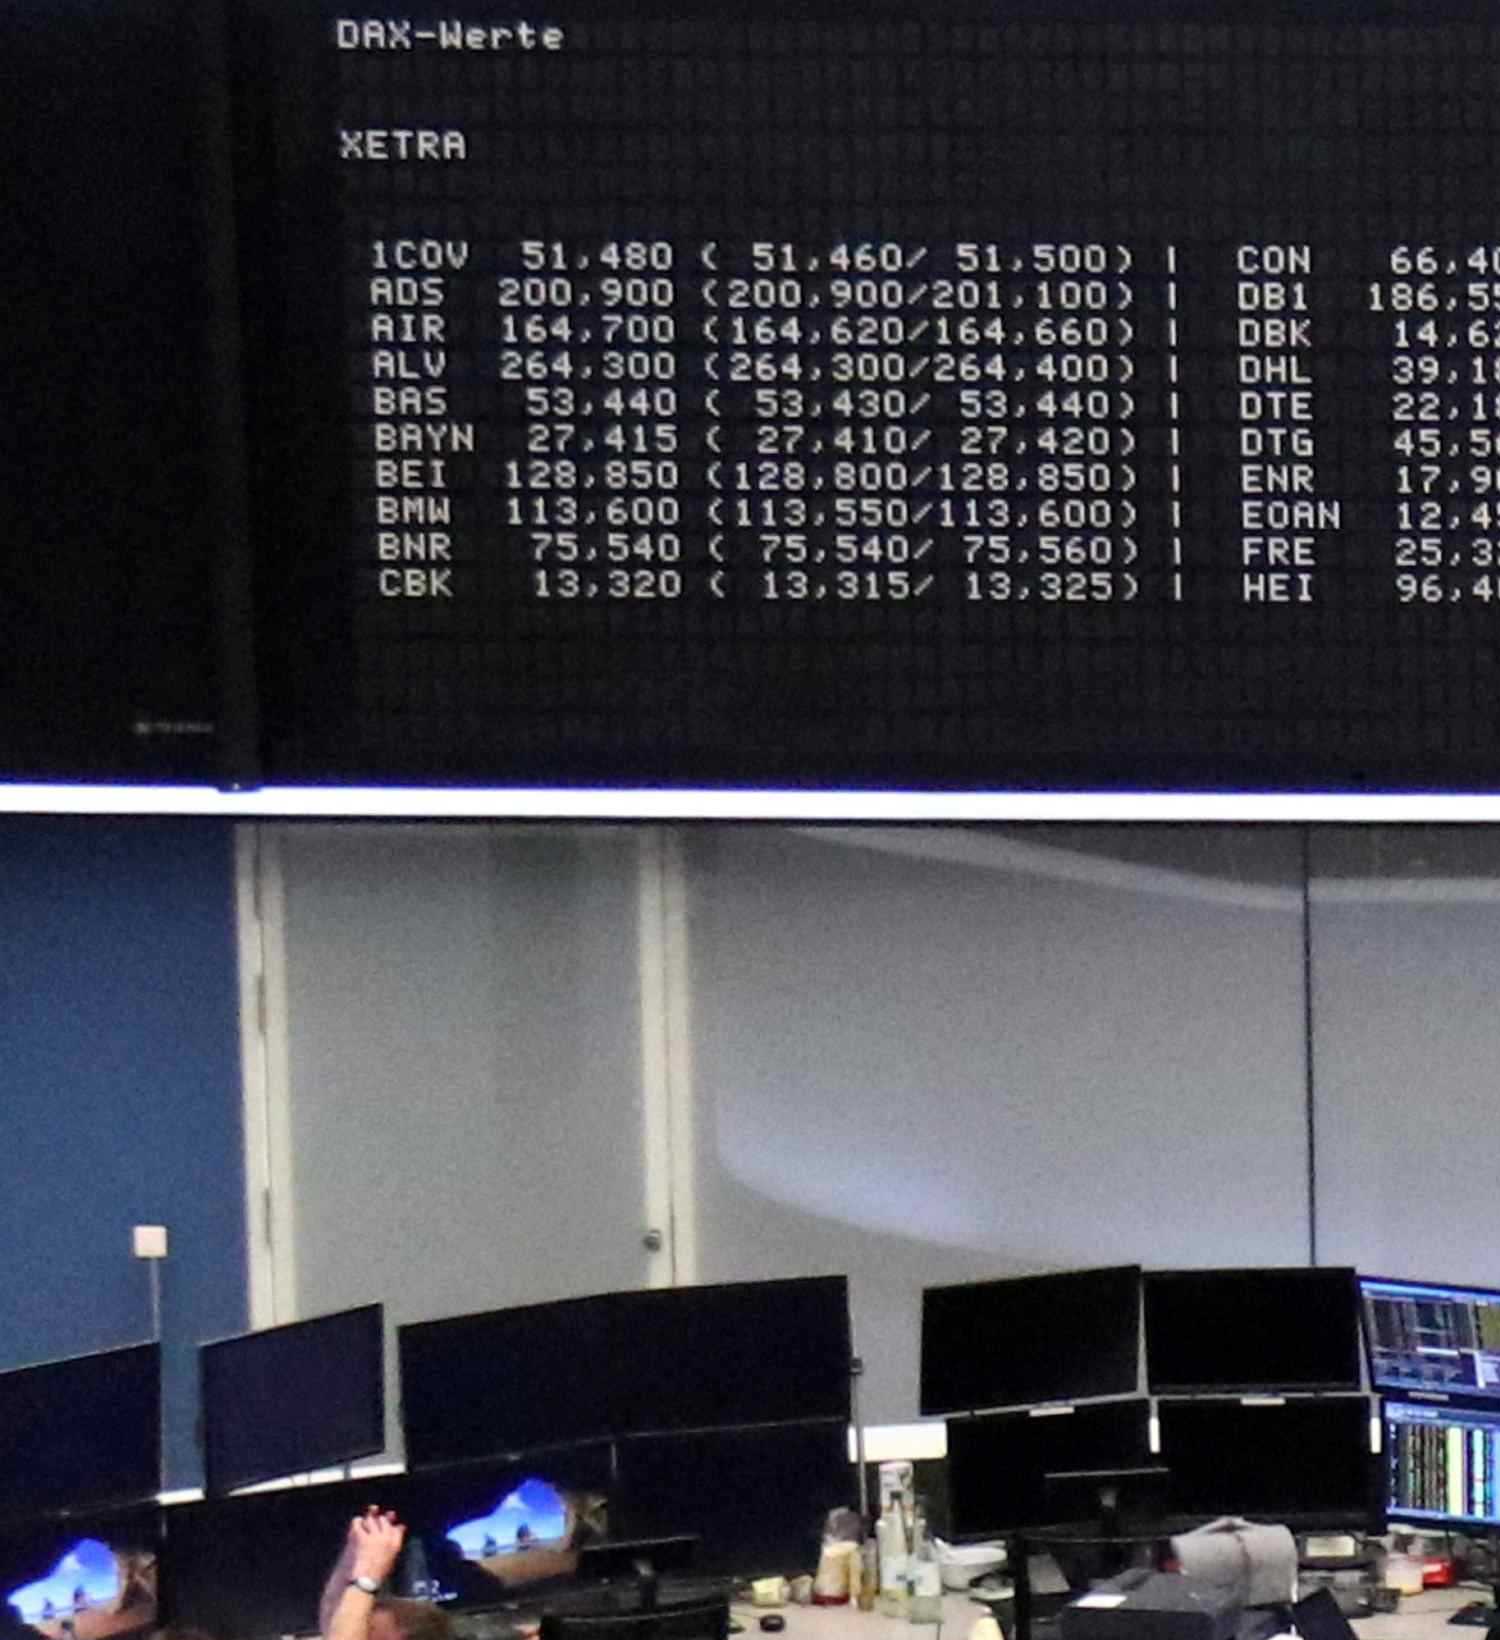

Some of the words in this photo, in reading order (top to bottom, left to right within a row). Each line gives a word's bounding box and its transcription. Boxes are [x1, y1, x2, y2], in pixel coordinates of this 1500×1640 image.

[336, 18, 565, 51] DAX-Werte
[339, 128, 467, 160] XETRA
[372, 238, 469, 271] 1COV
[521, 239, 674, 272] 51,480
[1236, 244, 1312, 276] CON
[369, 276, 445, 307] ADS
[498, 276, 675, 308] 200,900
[1237, 280, 1309, 312] DB1
[370, 312, 446, 343] AIR
[502, 313, 676, 344] 164,700
[1237, 317, 1312, 348] DBK
[372, 348, 447, 380] ALV
[500, 349, 676, 381] 264,300
[1238, 353, 1313, 385] DHL
[372, 385, 448, 416] BAS
[525, 386, 678, 418] 53,440
[1239, 389, 1314, 421] DTE
[374, 421, 474, 453] BAYN
[527, 422, 678, 454] 27,415
[1239, 426, 1315, 458] DTG
[374, 458, 446, 489] BEI
[505, 458, 679, 490] 128,850
[1240, 462, 1315, 494] ENR
[376, 494, 451, 525] BMW
[507, 495, 680, 526] 113,600
[1241, 499, 1341, 531] EOAN
[377, 531, 452, 562] BNR
[530, 531, 681, 563] 75,540
[1241, 535, 1316, 567] FRE
[378, 567, 453, 598] CBK
[534, 568, 682, 599] 13,320
[1242, 572, 1313, 603] HEI
